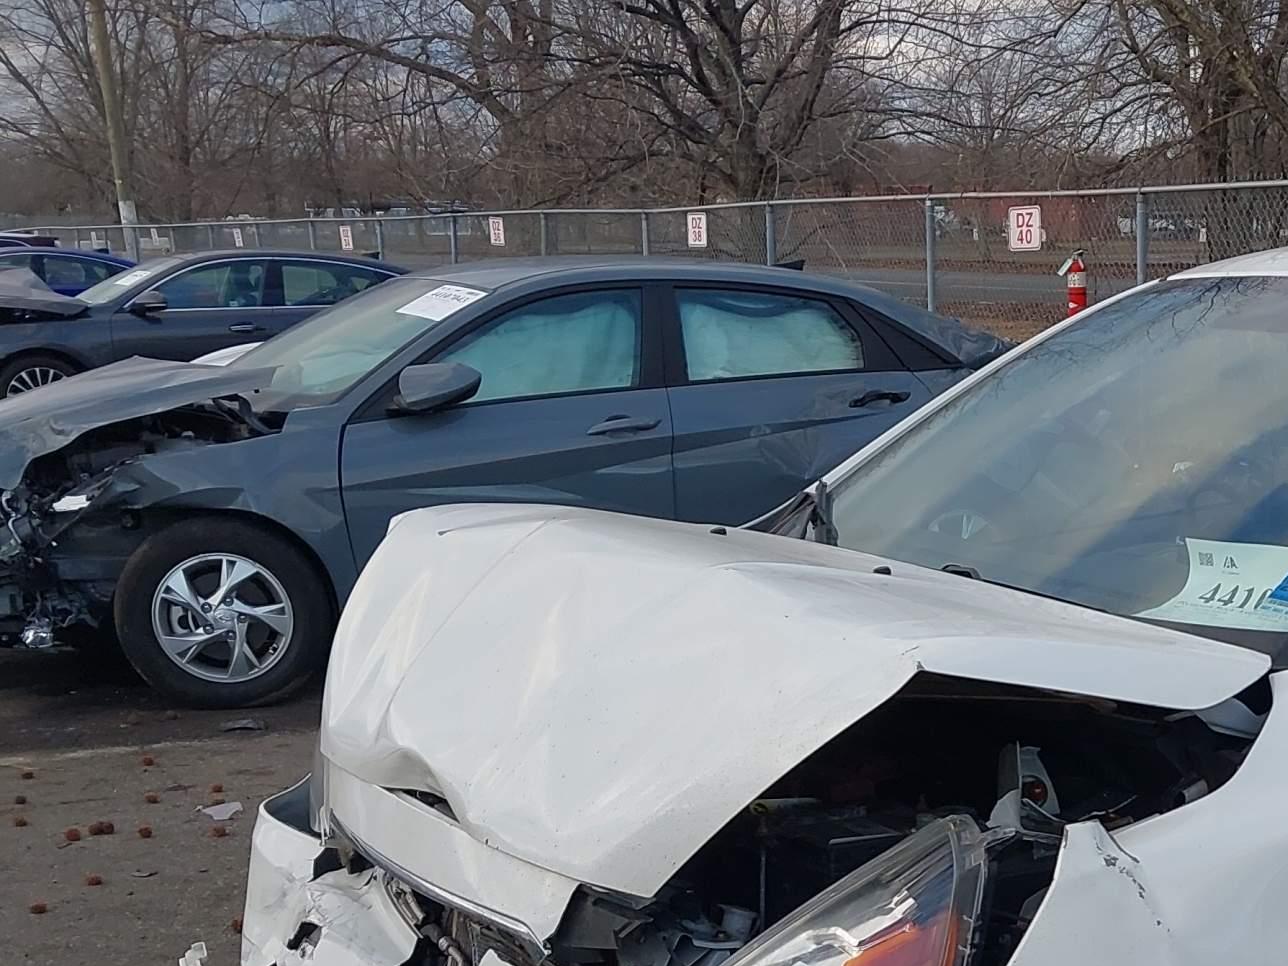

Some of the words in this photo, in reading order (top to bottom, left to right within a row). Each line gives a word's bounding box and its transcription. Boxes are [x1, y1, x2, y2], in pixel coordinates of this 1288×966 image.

[691, 217, 703, 230] DZ
[1016, 212, 1034, 228] DZ
[692, 230, 702, 242] 38
[1016, 229, 1032, 244] 40
